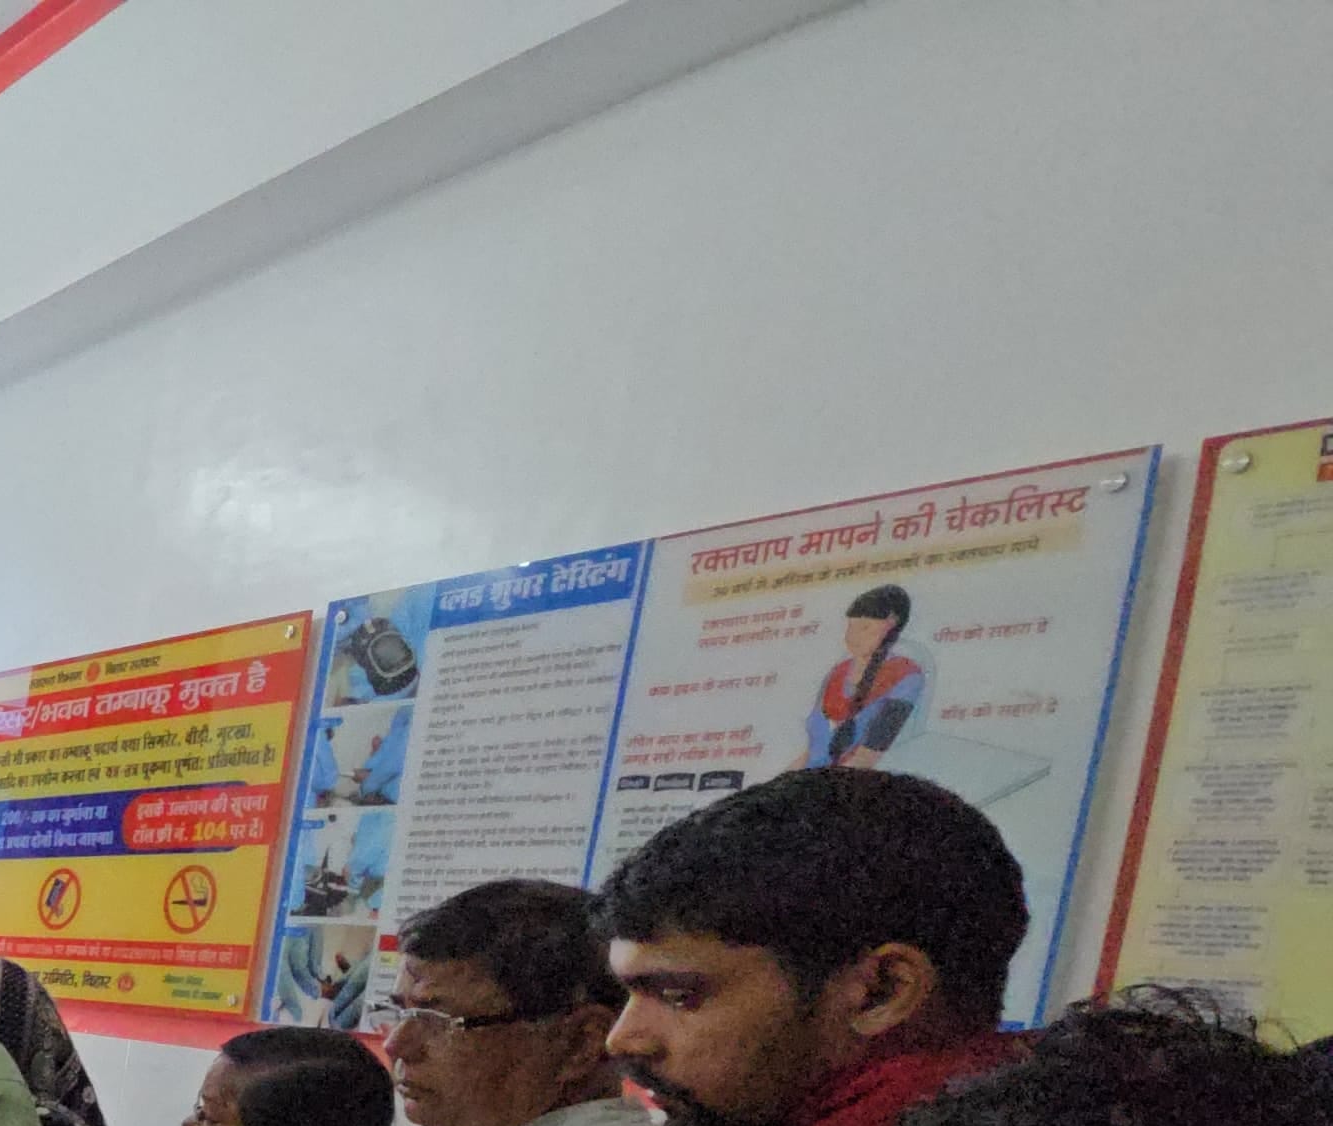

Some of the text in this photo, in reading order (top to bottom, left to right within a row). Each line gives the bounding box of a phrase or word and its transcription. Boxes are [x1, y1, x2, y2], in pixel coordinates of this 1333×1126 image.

[691, 485, 1092, 574] रक्तचाप मापने की चेकलिस्ट
[489, 571, 548, 610] शुगर
[95, 683, 175, 715] तम्बाकू
[179, 672, 242, 712] मुक्त
[245, 660, 272, 694] है
[192, 820, 228, 841] 104
